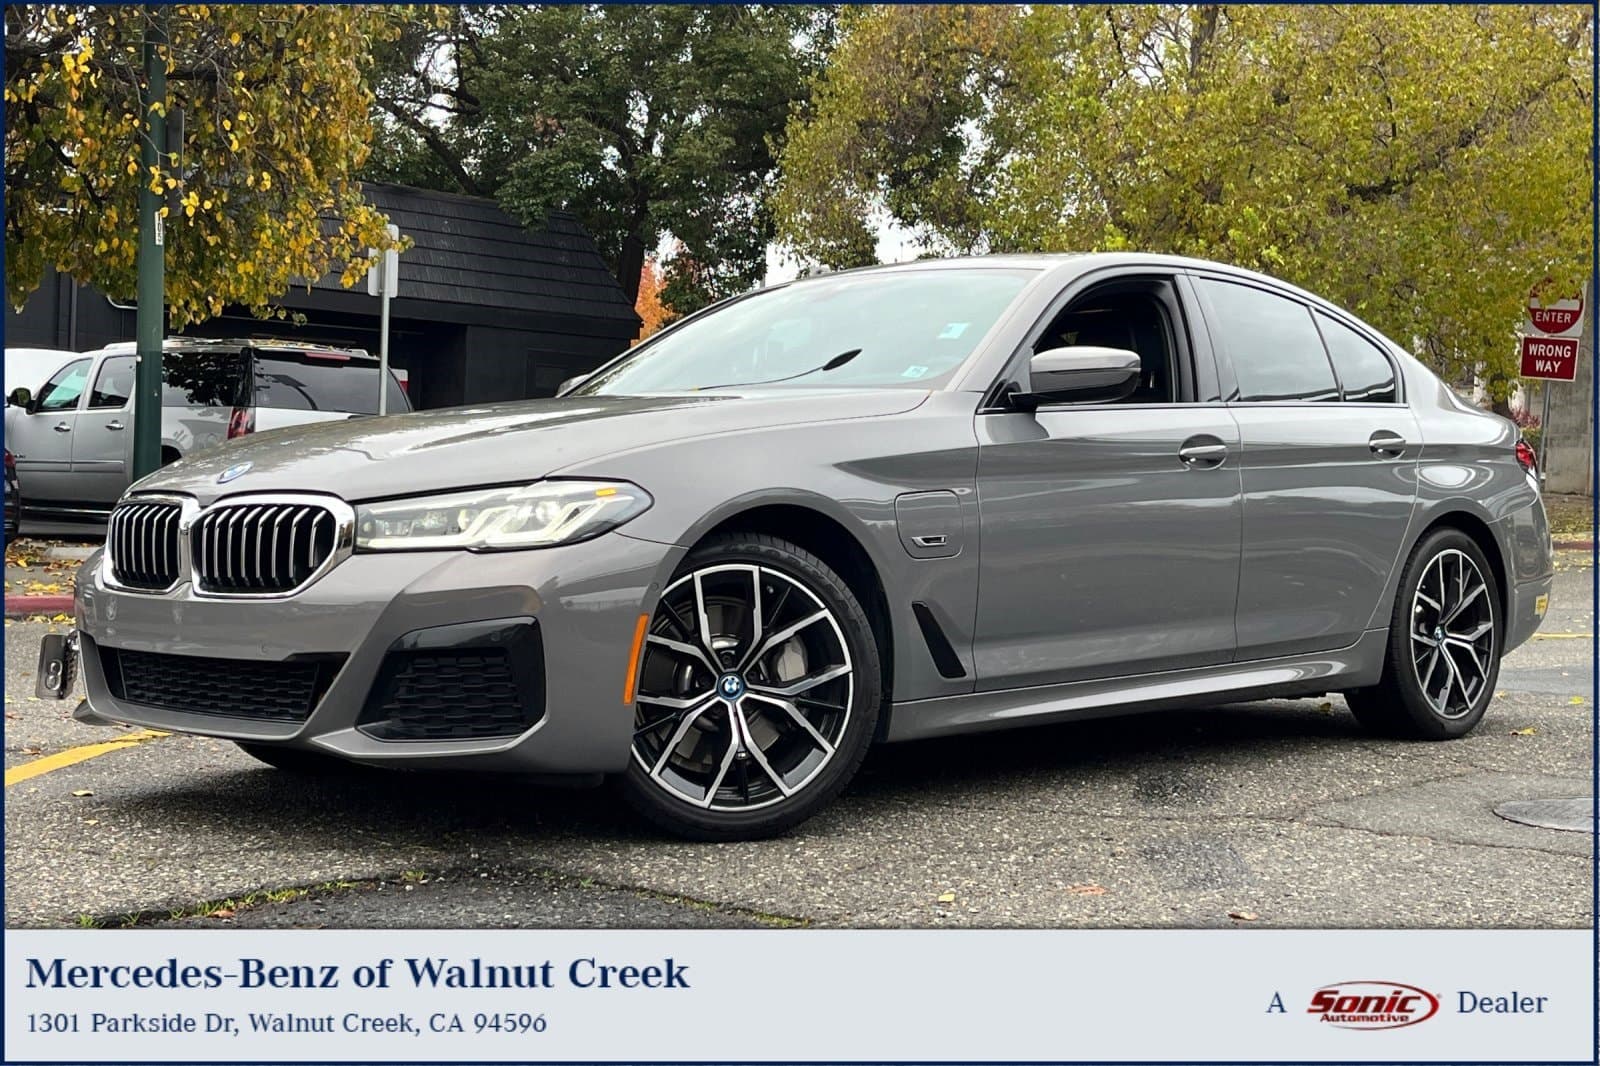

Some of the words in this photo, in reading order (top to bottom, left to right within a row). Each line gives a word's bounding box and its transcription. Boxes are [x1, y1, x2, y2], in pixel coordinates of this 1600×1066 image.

[1535, 311, 1572, 324] ENTER
[1528, 343, 1572, 358] WRONG
[1535, 360, 1562, 373] WAY
